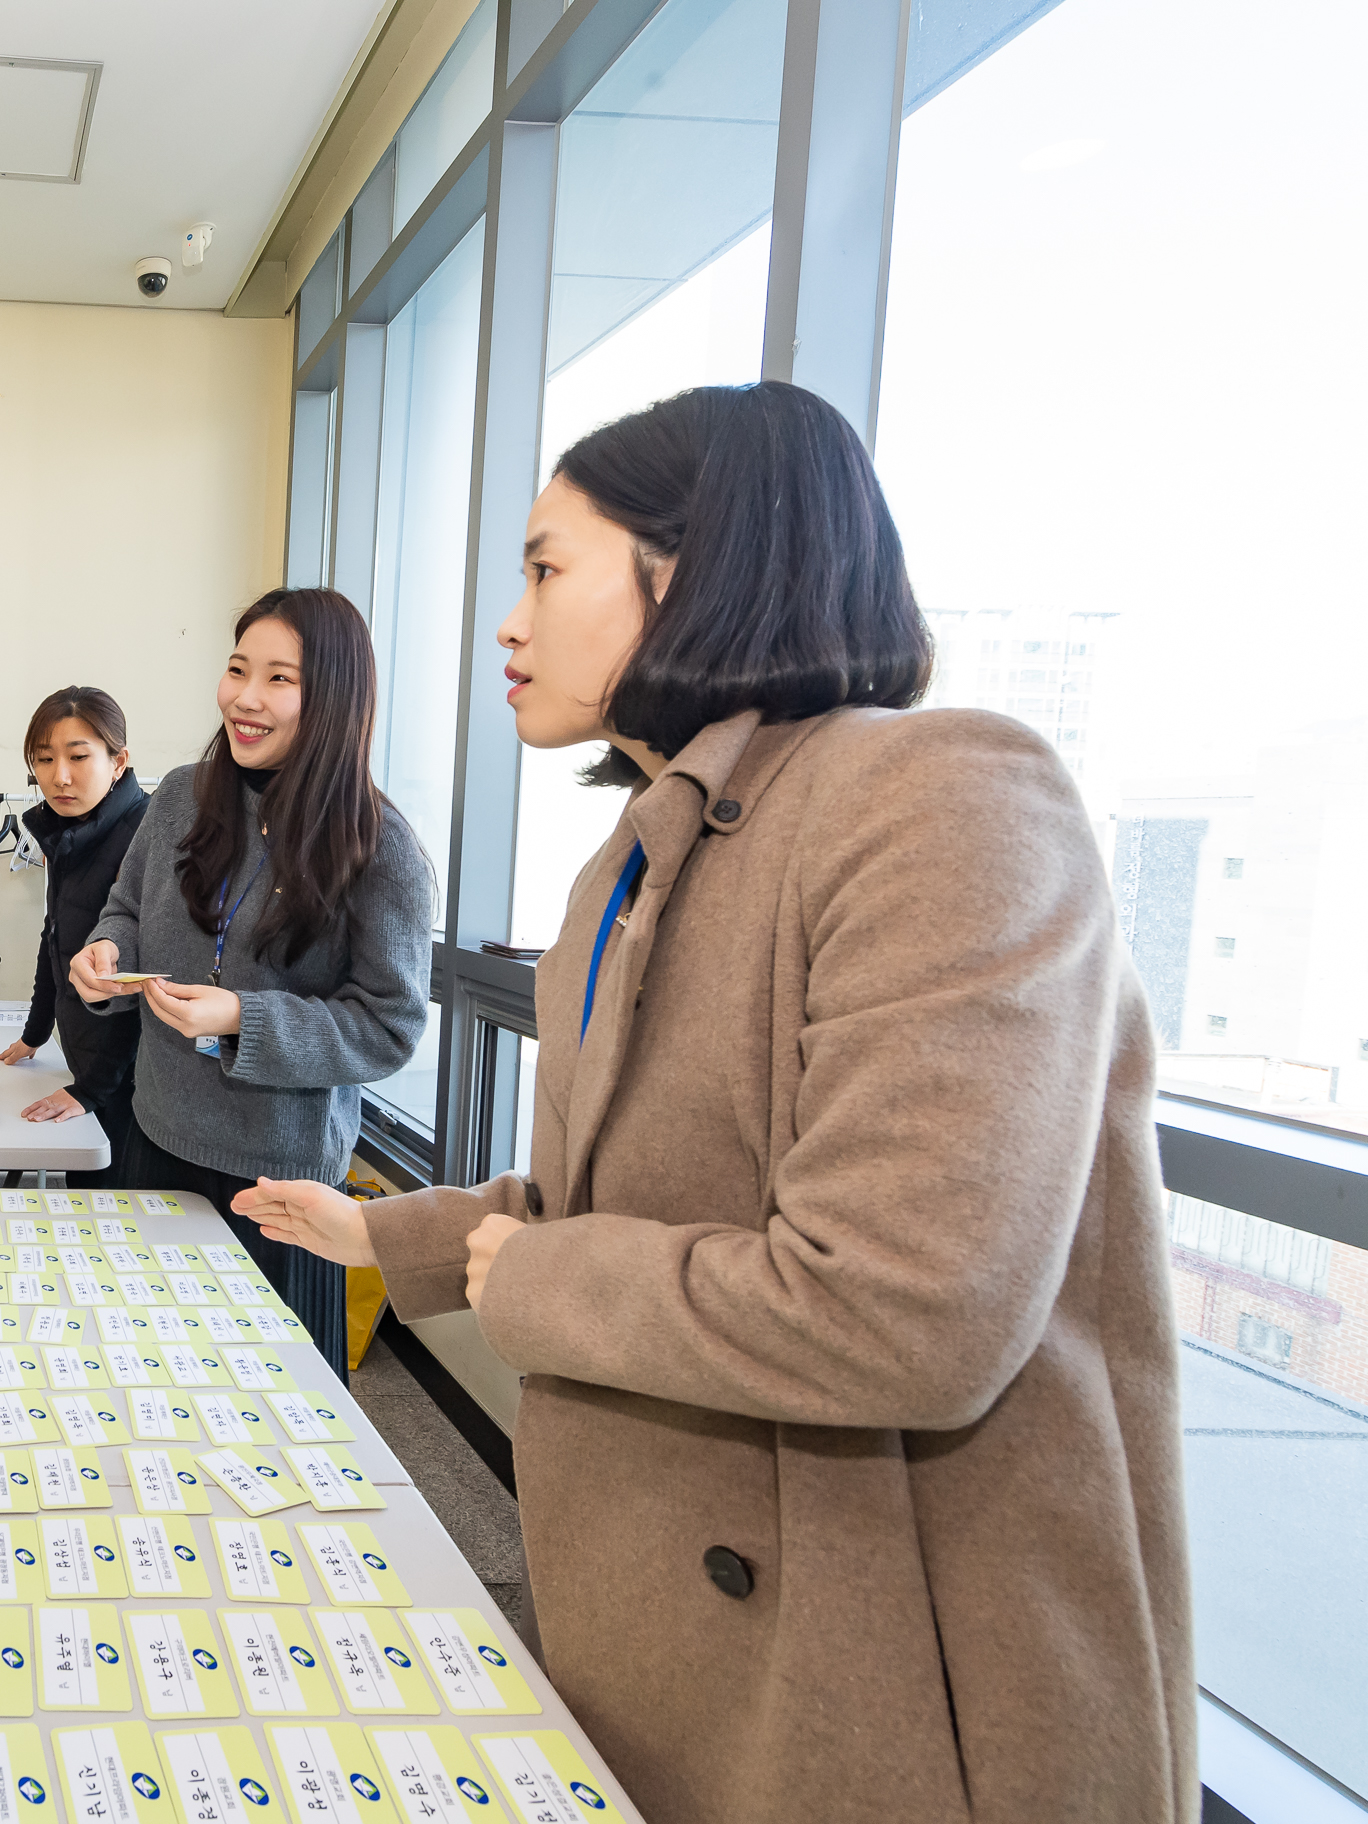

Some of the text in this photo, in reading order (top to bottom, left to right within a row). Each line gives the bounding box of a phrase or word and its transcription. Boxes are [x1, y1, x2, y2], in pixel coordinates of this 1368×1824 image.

[58, 1681, 69, 1690] 님
[150, 1641, 173, 1697] 강용구 님
[245, 1635, 272, 1696] 이종원 님
[336, 1634, 366, 1693] 정규옥 님
[454, 1684, 465, 1694] 님
[79, 1766, 106, 1818] 신기남
[105, 1756, 130, 1820] 현대프라임아파트
[189, 1770, 217, 1819] 이종경
[298, 1761, 327, 1809] 이광성
[401, 1766, 435, 1817] 김명수
[515, 1774, 559, 1822] 김기정
